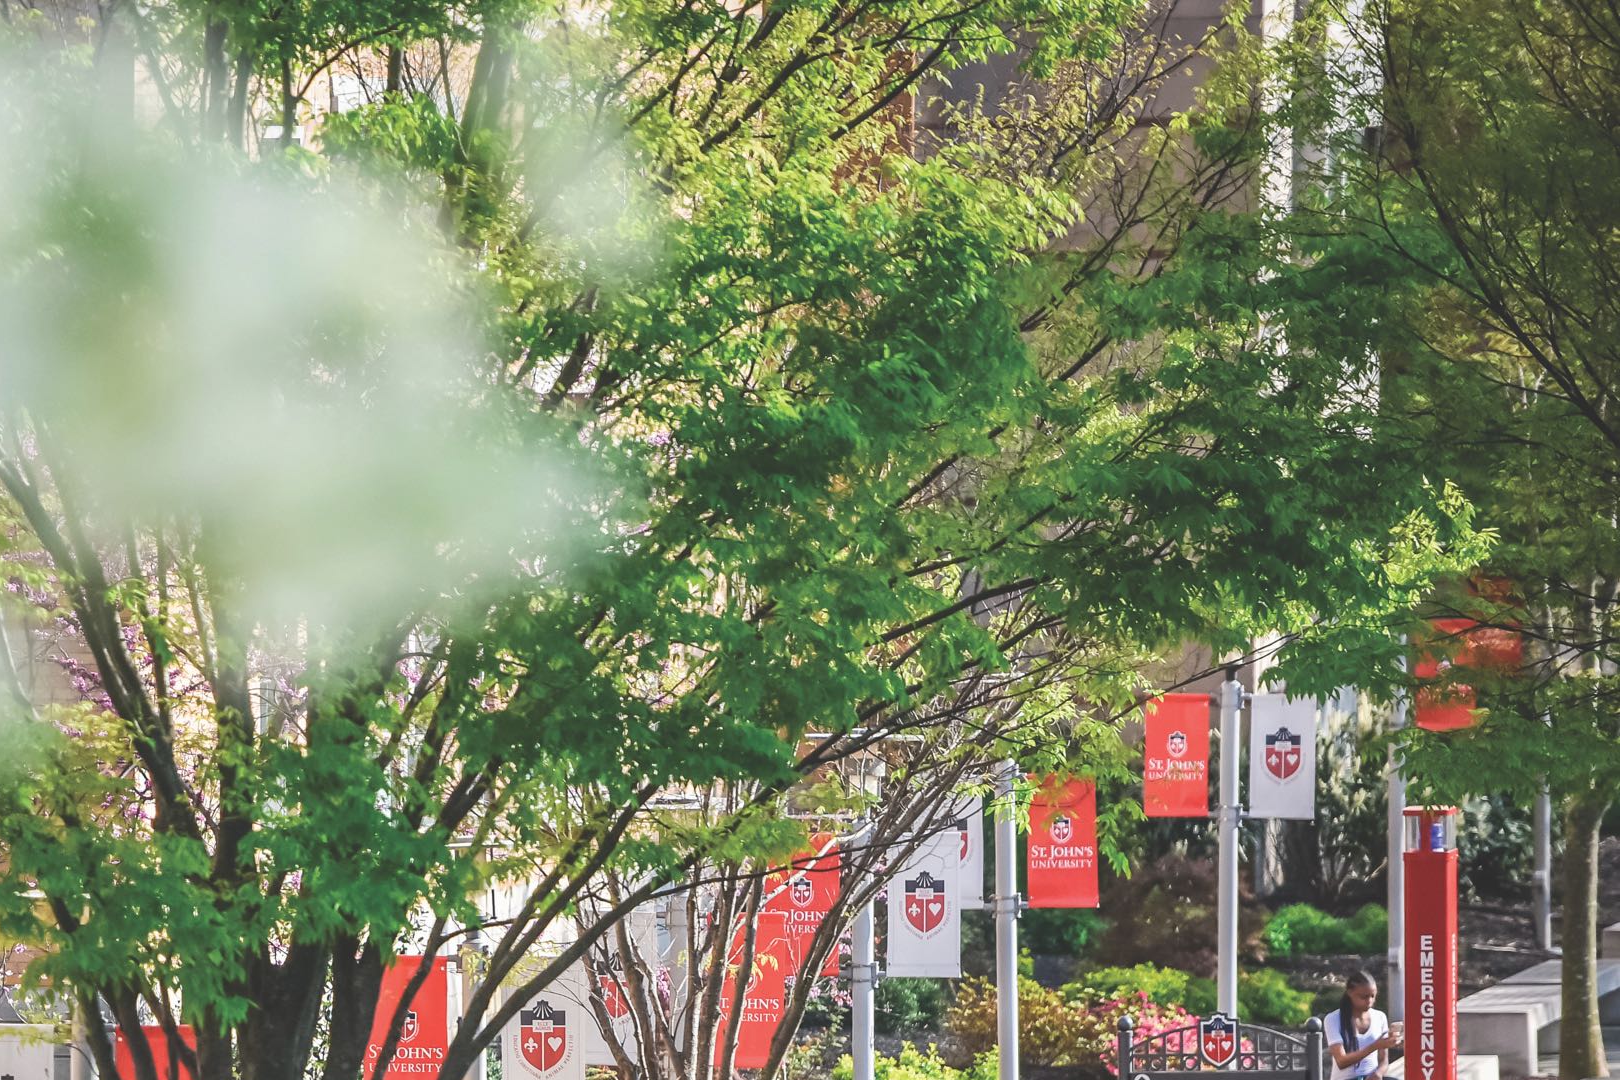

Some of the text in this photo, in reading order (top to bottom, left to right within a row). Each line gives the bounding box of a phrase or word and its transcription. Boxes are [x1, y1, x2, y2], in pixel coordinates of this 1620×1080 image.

[1031, 845, 1094, 860] ST. JOHN'S
[1032, 860, 1092, 868] UNIVERSITY
[789, 909, 828, 924] JOHN'
[369, 1063, 442, 1073] UIVERSITY
